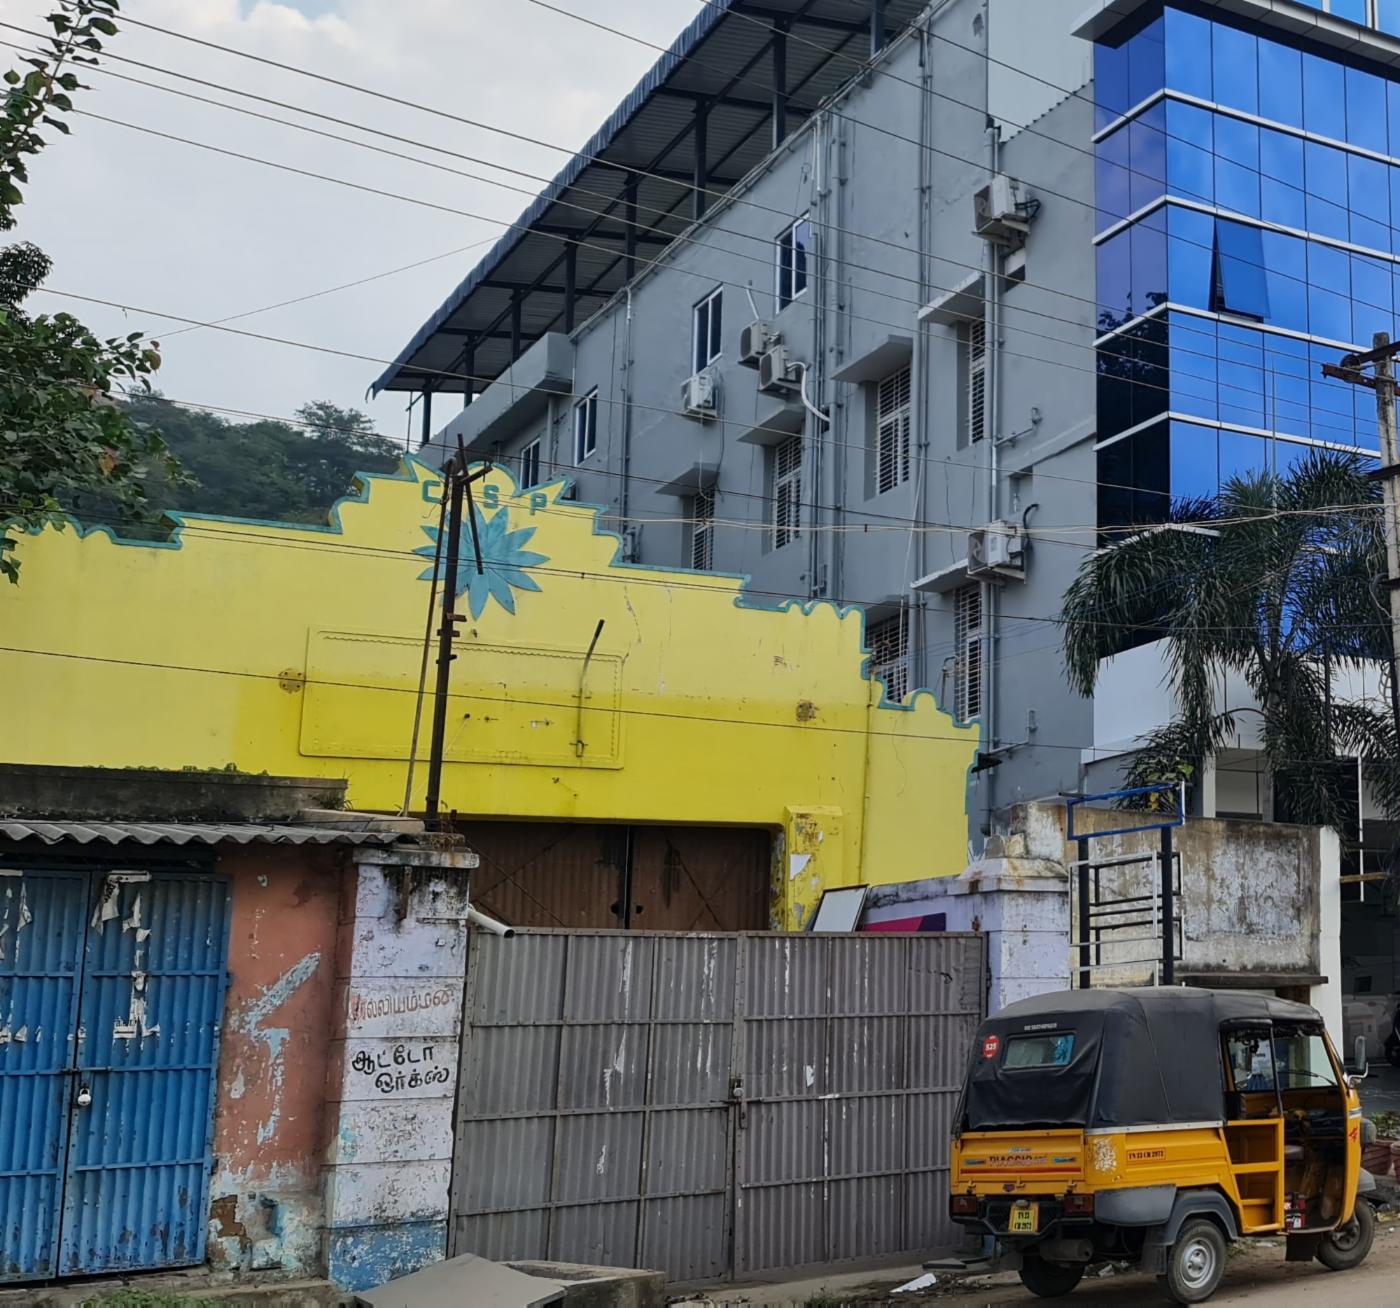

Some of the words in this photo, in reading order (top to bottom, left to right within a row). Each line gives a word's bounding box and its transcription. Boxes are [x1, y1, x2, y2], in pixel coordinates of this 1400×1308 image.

[483, 485, 499, 508] S
[530, 493, 547, 516] P
[351, 1044, 434, 1075] ஆட்டோ
